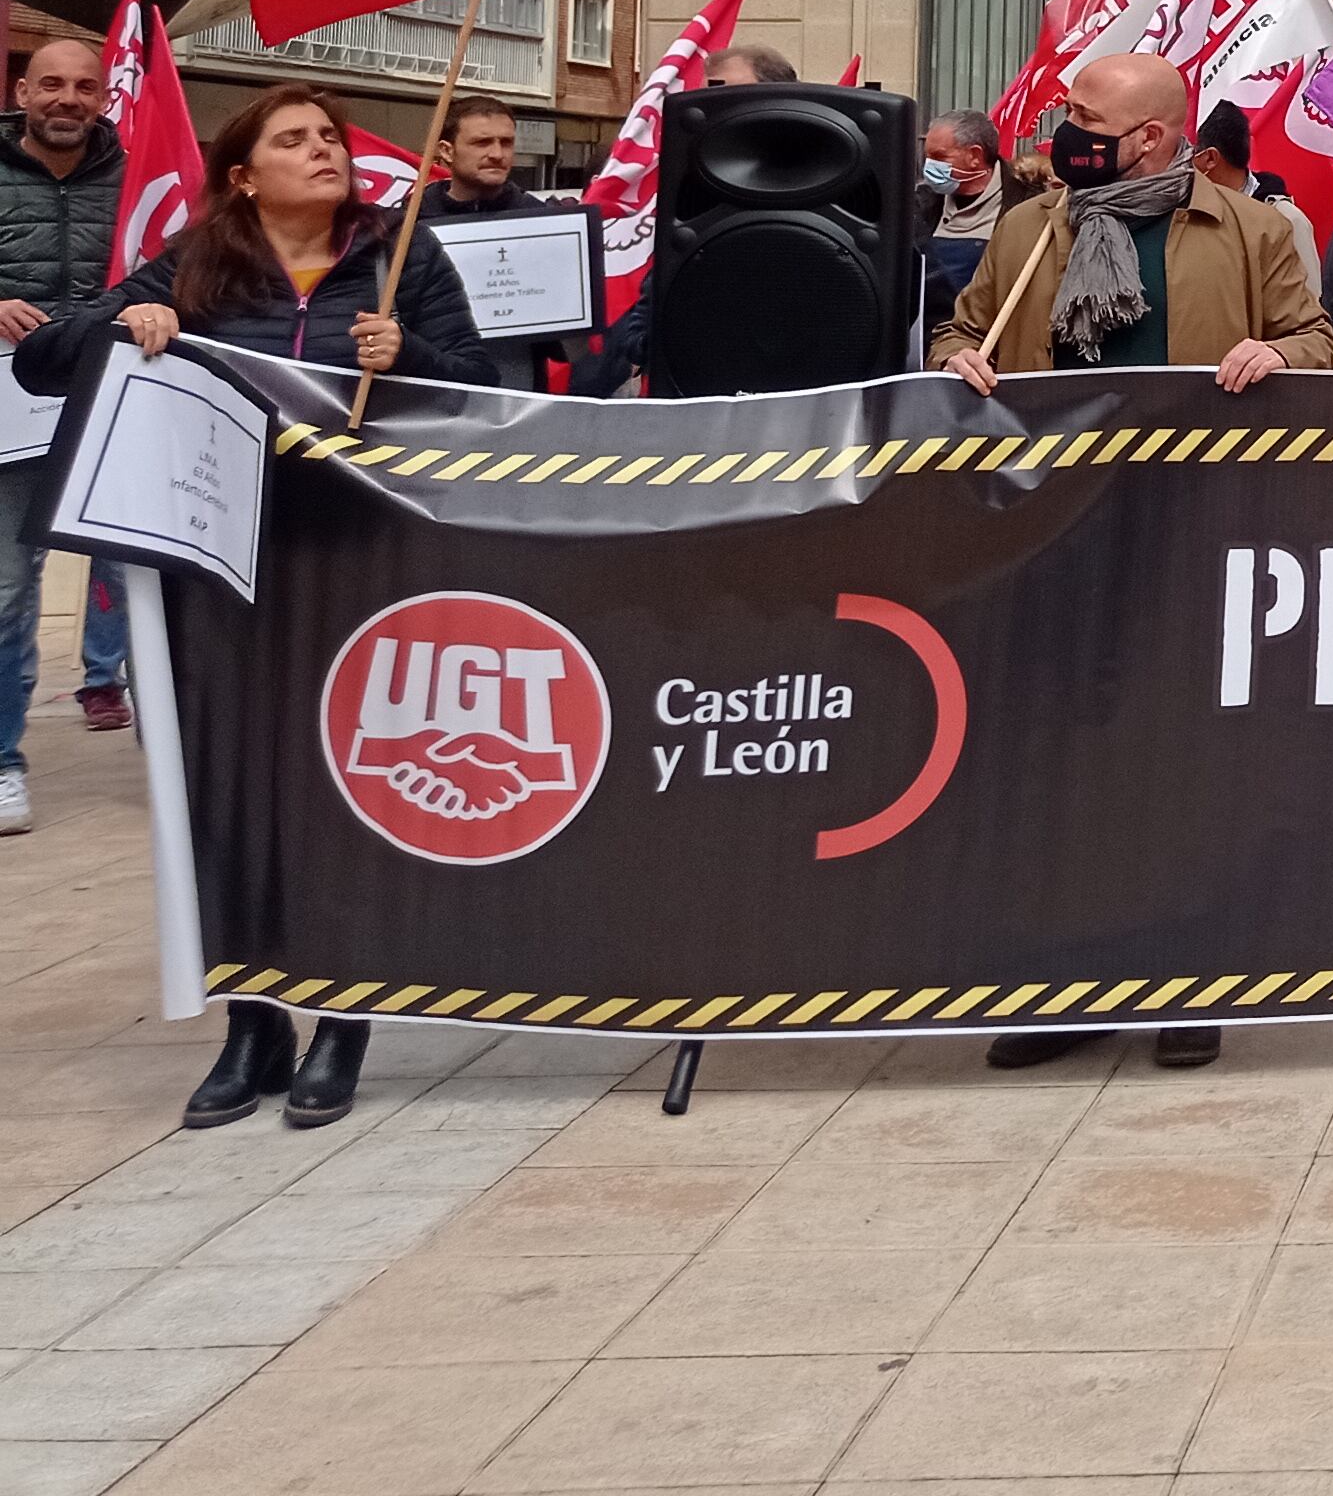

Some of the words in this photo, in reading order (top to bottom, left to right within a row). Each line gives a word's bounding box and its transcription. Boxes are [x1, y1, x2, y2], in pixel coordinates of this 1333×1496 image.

[1202, 12, 1277, 89] alencia
[358, 636, 566, 751] UGT
[655, 674, 854, 727] Castilla
[653, 745, 684, 793] y
[702, 725, 830, 777] León
